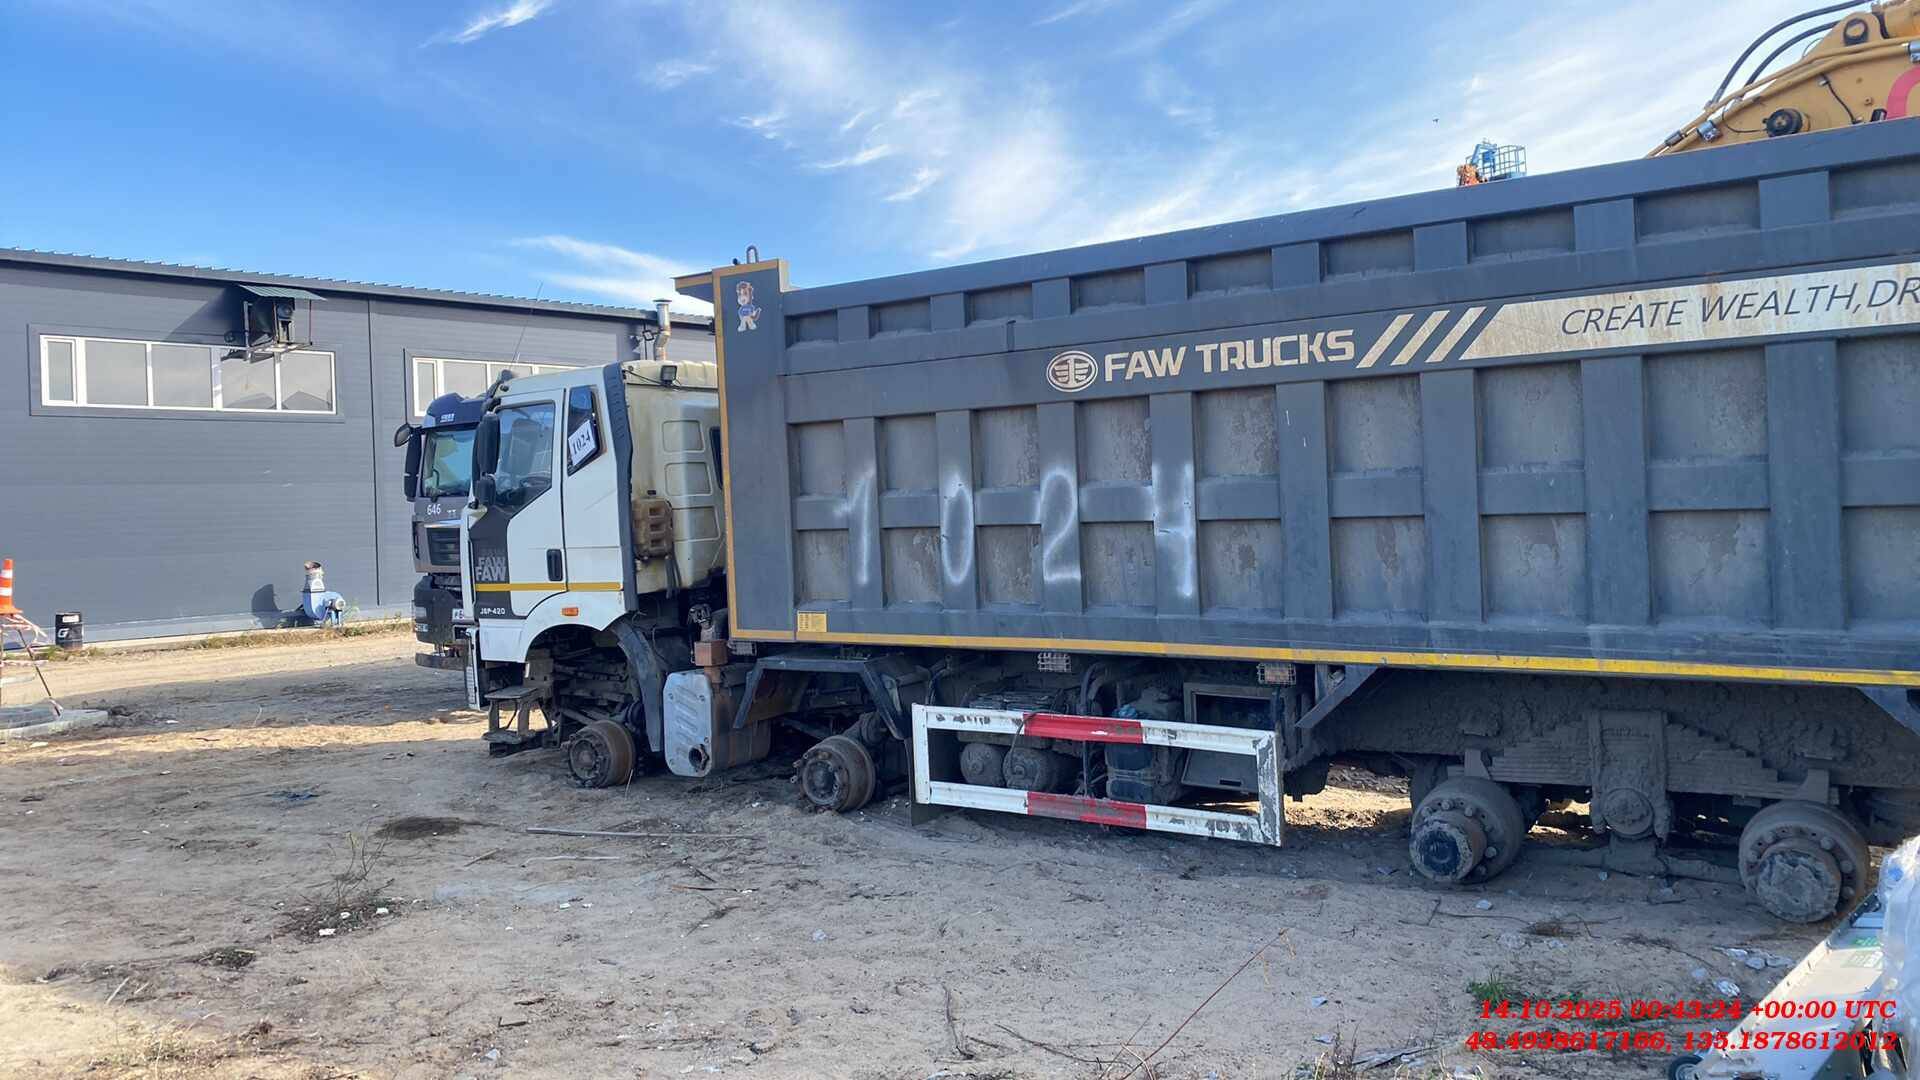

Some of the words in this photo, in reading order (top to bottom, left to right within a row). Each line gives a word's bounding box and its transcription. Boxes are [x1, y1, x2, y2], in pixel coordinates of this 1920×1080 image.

[1561, 298, 1688, 336] CREATE
[1104, 346, 1188, 382] FAW
[1195, 329, 1354, 373] TRUCKS
[573, 429, 591, 455] 1024
[426, 503, 441, 516] 646
[832, 462, 1196, 599] 1024
[475, 566, 507, 582] FAW
[478, 556, 506, 568] FAW
